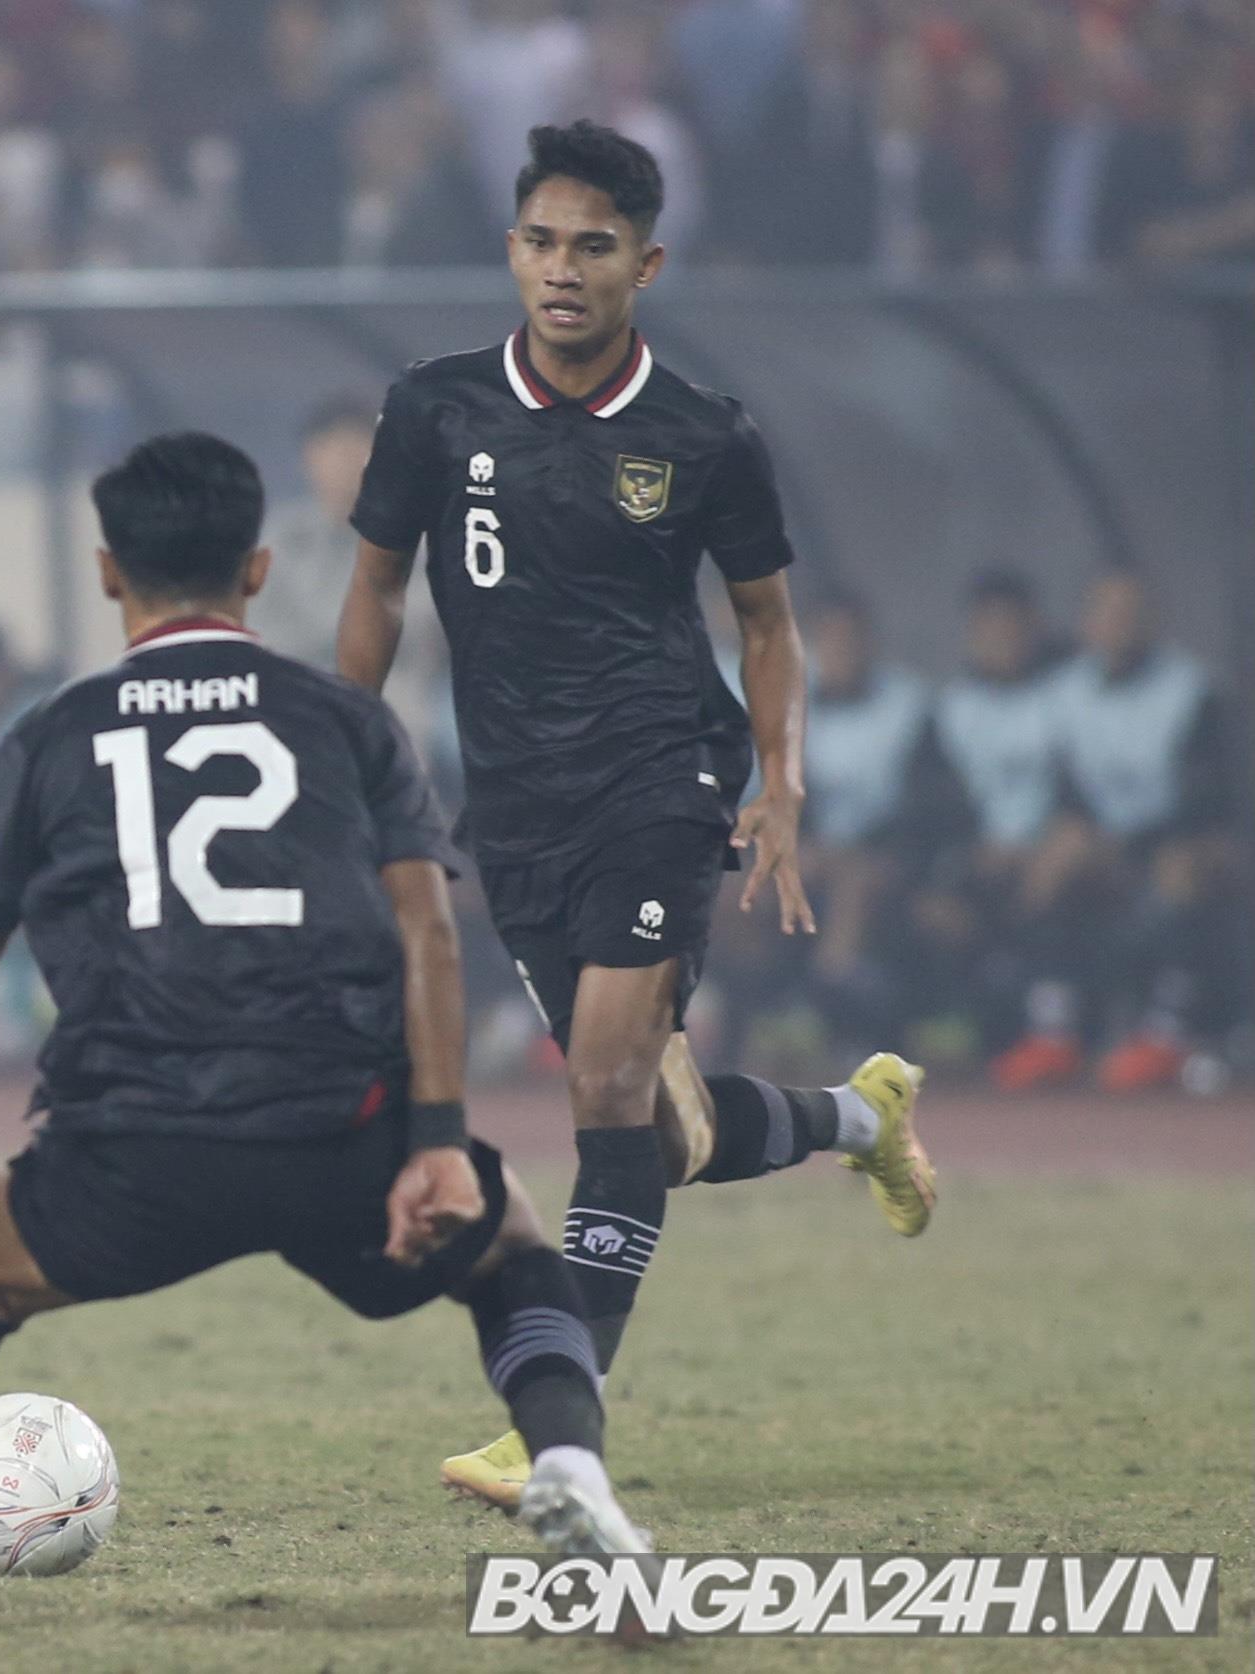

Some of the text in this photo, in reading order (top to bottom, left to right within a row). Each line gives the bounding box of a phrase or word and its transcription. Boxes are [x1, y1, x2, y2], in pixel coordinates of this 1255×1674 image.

[465, 507, 505, 588] 6
[119, 673, 258, 715] ARHAN
[93, 721, 304, 930] 12
